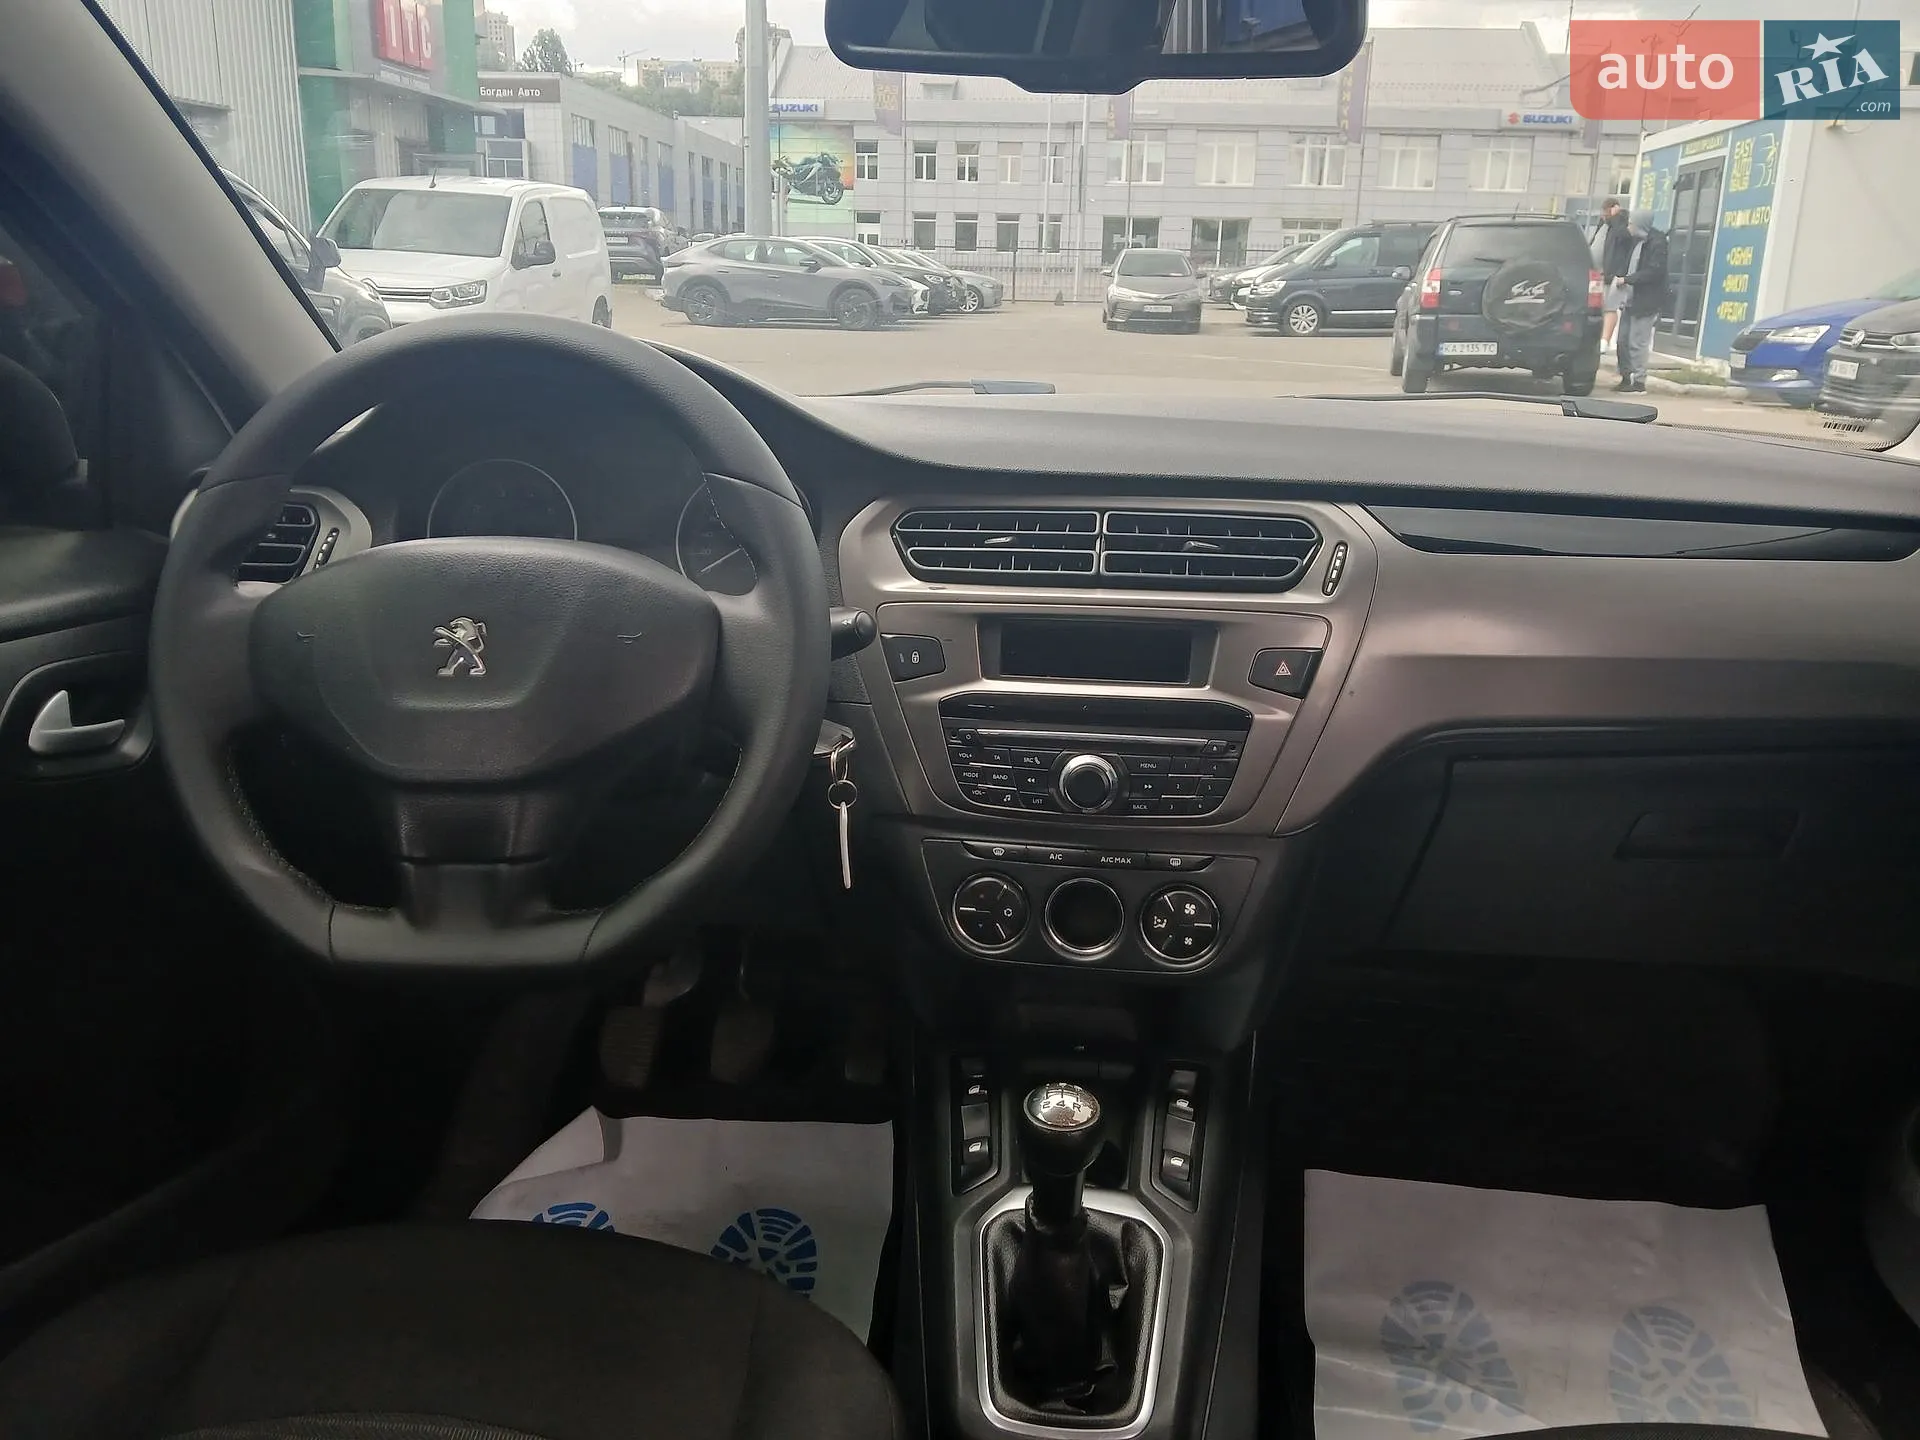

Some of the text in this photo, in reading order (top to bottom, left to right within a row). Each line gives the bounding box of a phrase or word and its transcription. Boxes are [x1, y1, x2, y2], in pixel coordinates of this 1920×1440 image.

[479, 86, 541, 98] Богдан Авто
[771, 103, 819, 113] SUZUKI
[1522, 114, 1573, 125] SUZUKI
[1049, 853, 1063, 861] A/C
[1114, 857, 1132, 865] MAX
[1072, 1102, 1082, 1113] R
